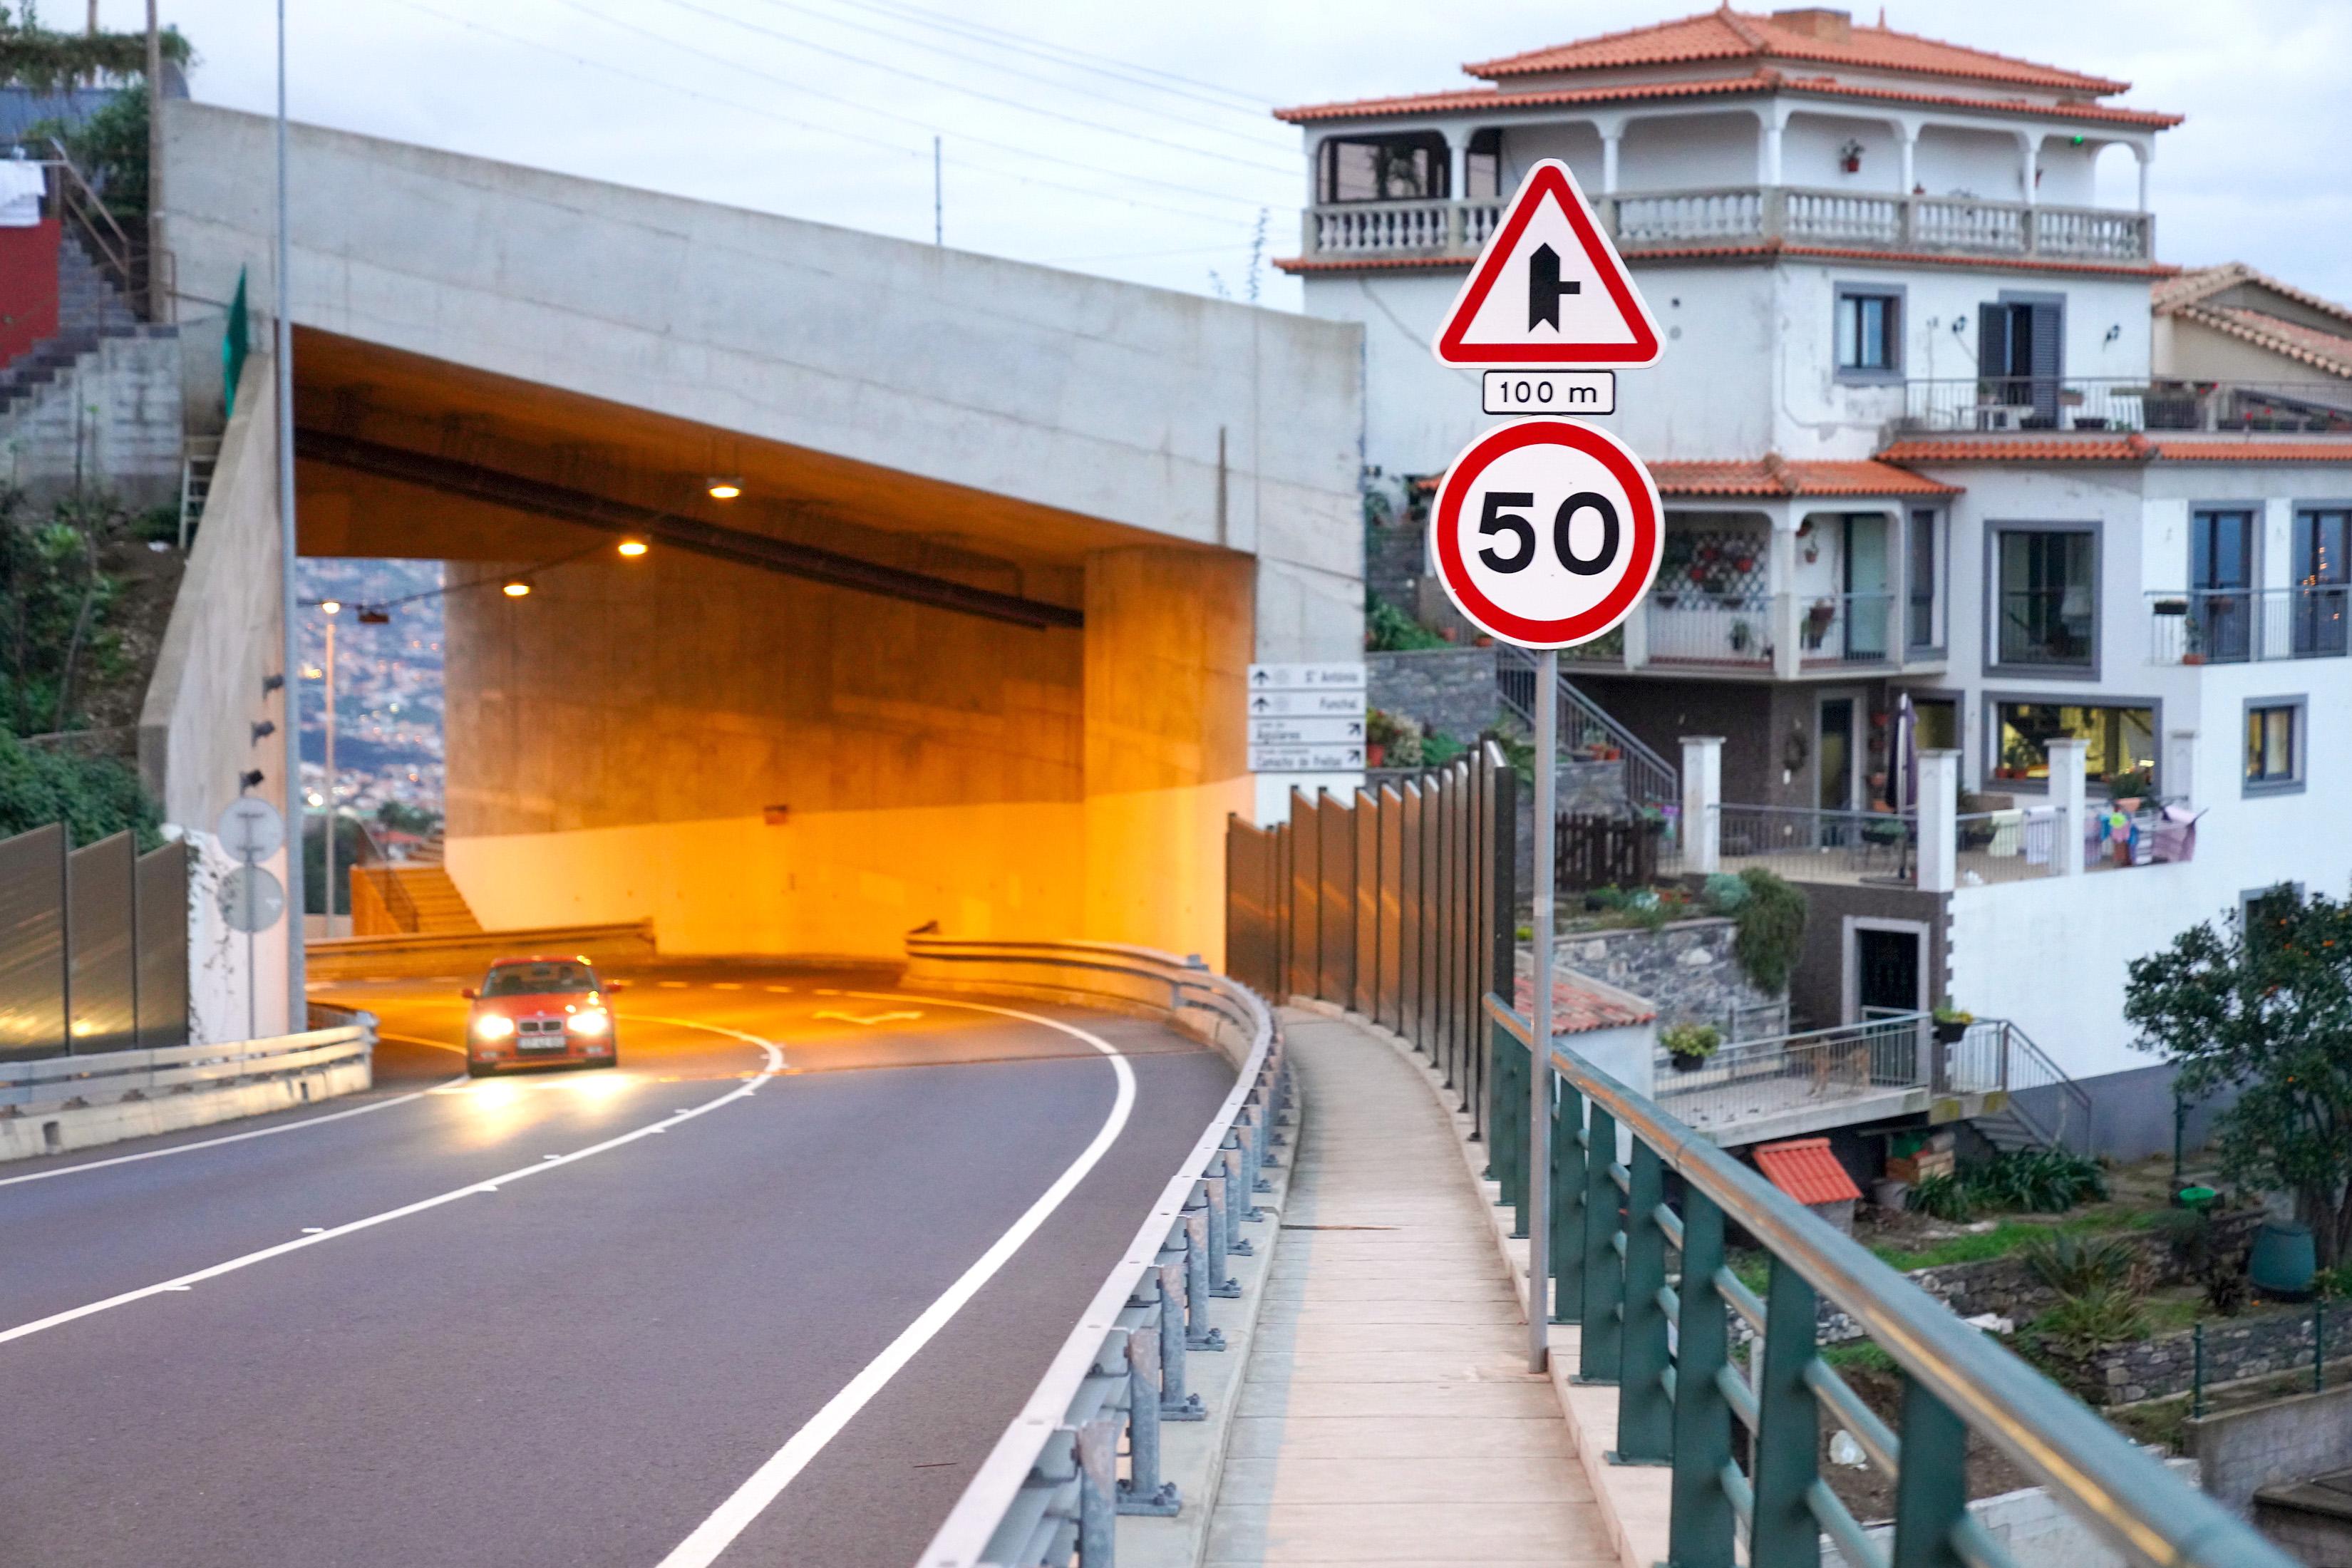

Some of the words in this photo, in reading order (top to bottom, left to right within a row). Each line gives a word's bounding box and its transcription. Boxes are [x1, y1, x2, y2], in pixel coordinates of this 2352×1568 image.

[1500, 381, 1553, 403] 100
[1569, 386, 1597, 403] m
[1478, 492, 1619, 576] 50
